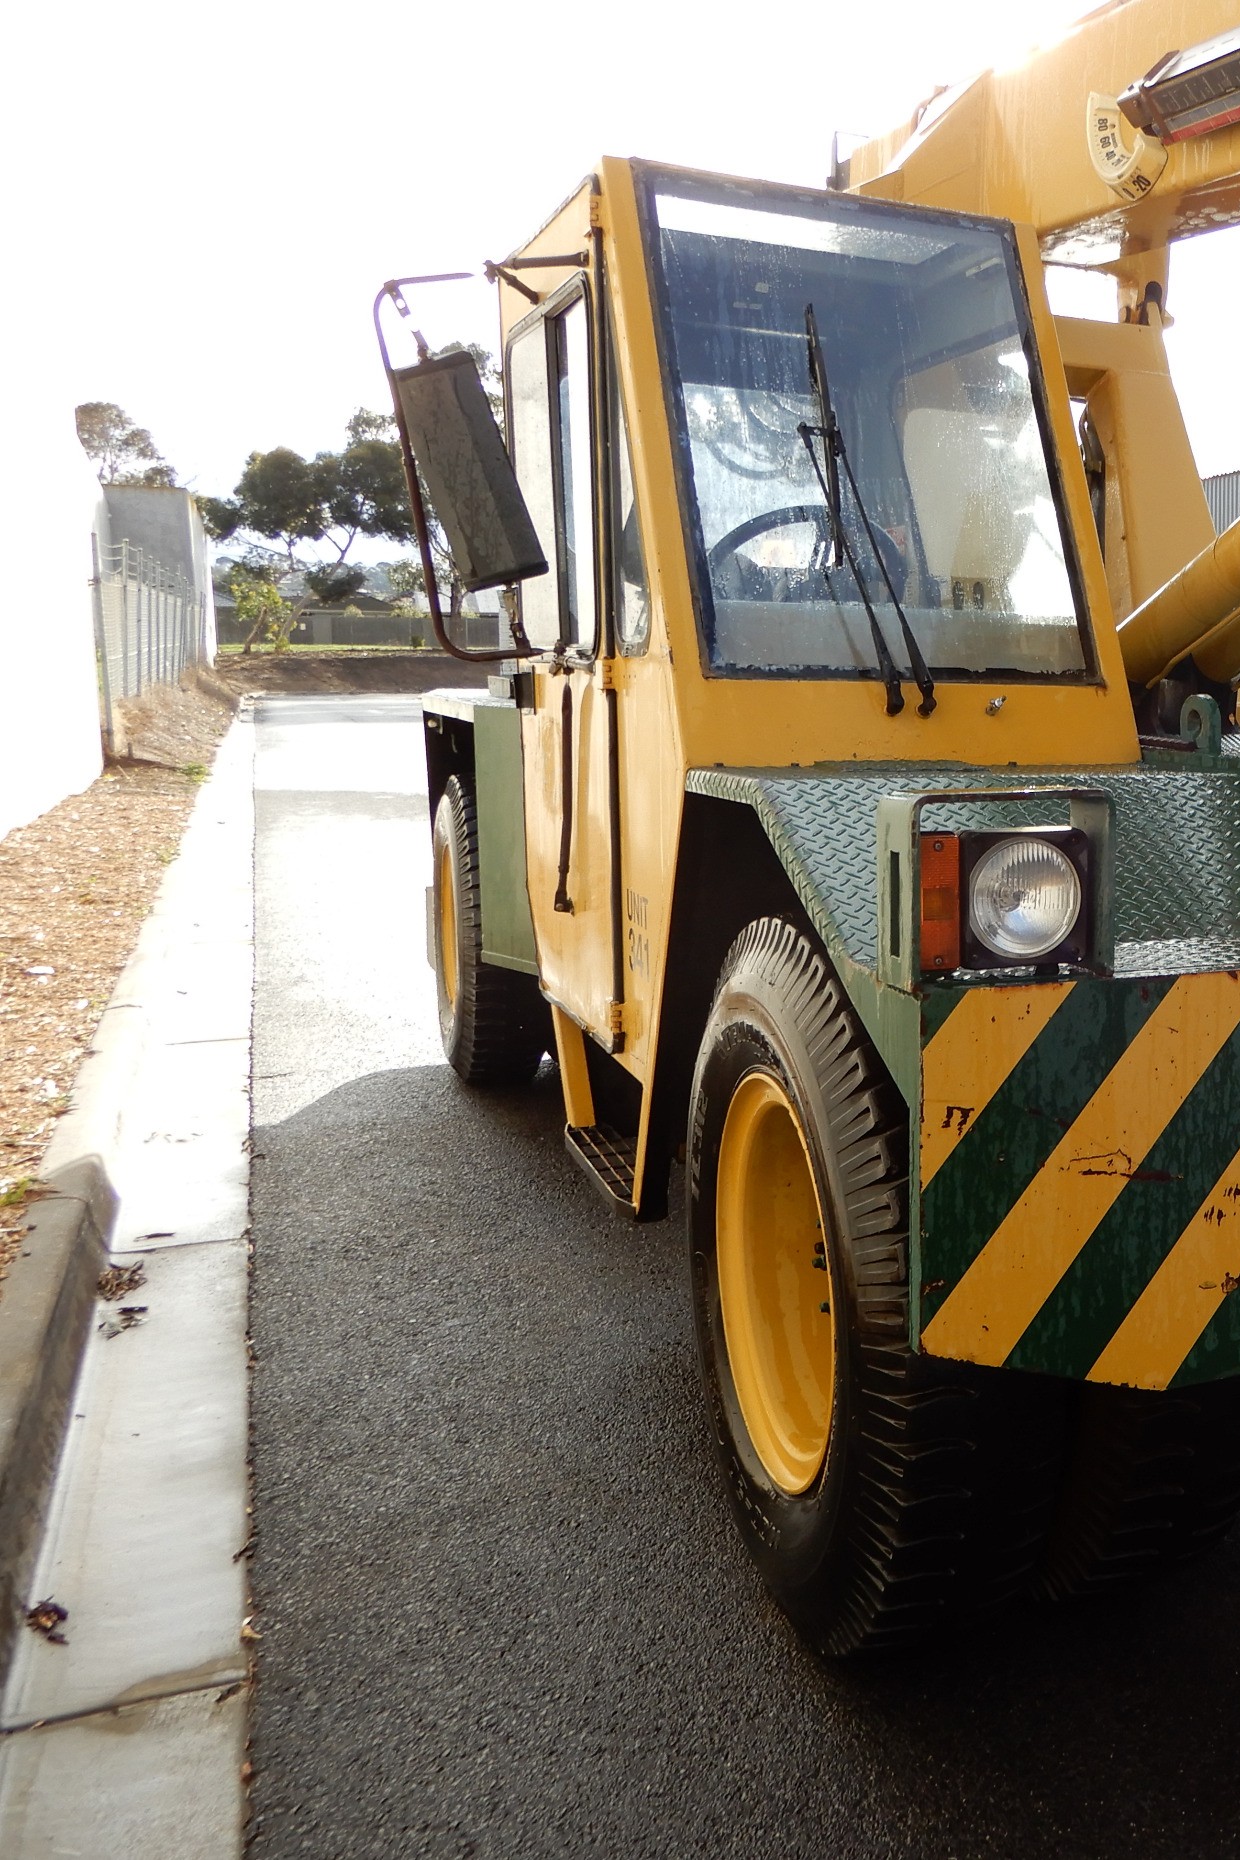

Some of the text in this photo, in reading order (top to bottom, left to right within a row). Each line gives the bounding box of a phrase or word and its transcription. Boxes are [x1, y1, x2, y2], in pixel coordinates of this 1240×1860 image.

[1098, 118, 1108, 132] 80
[1100, 136, 1111, 149] 60
[1105, 150, 1117, 161] 40
[626, 888, 649, 930] UNIT
